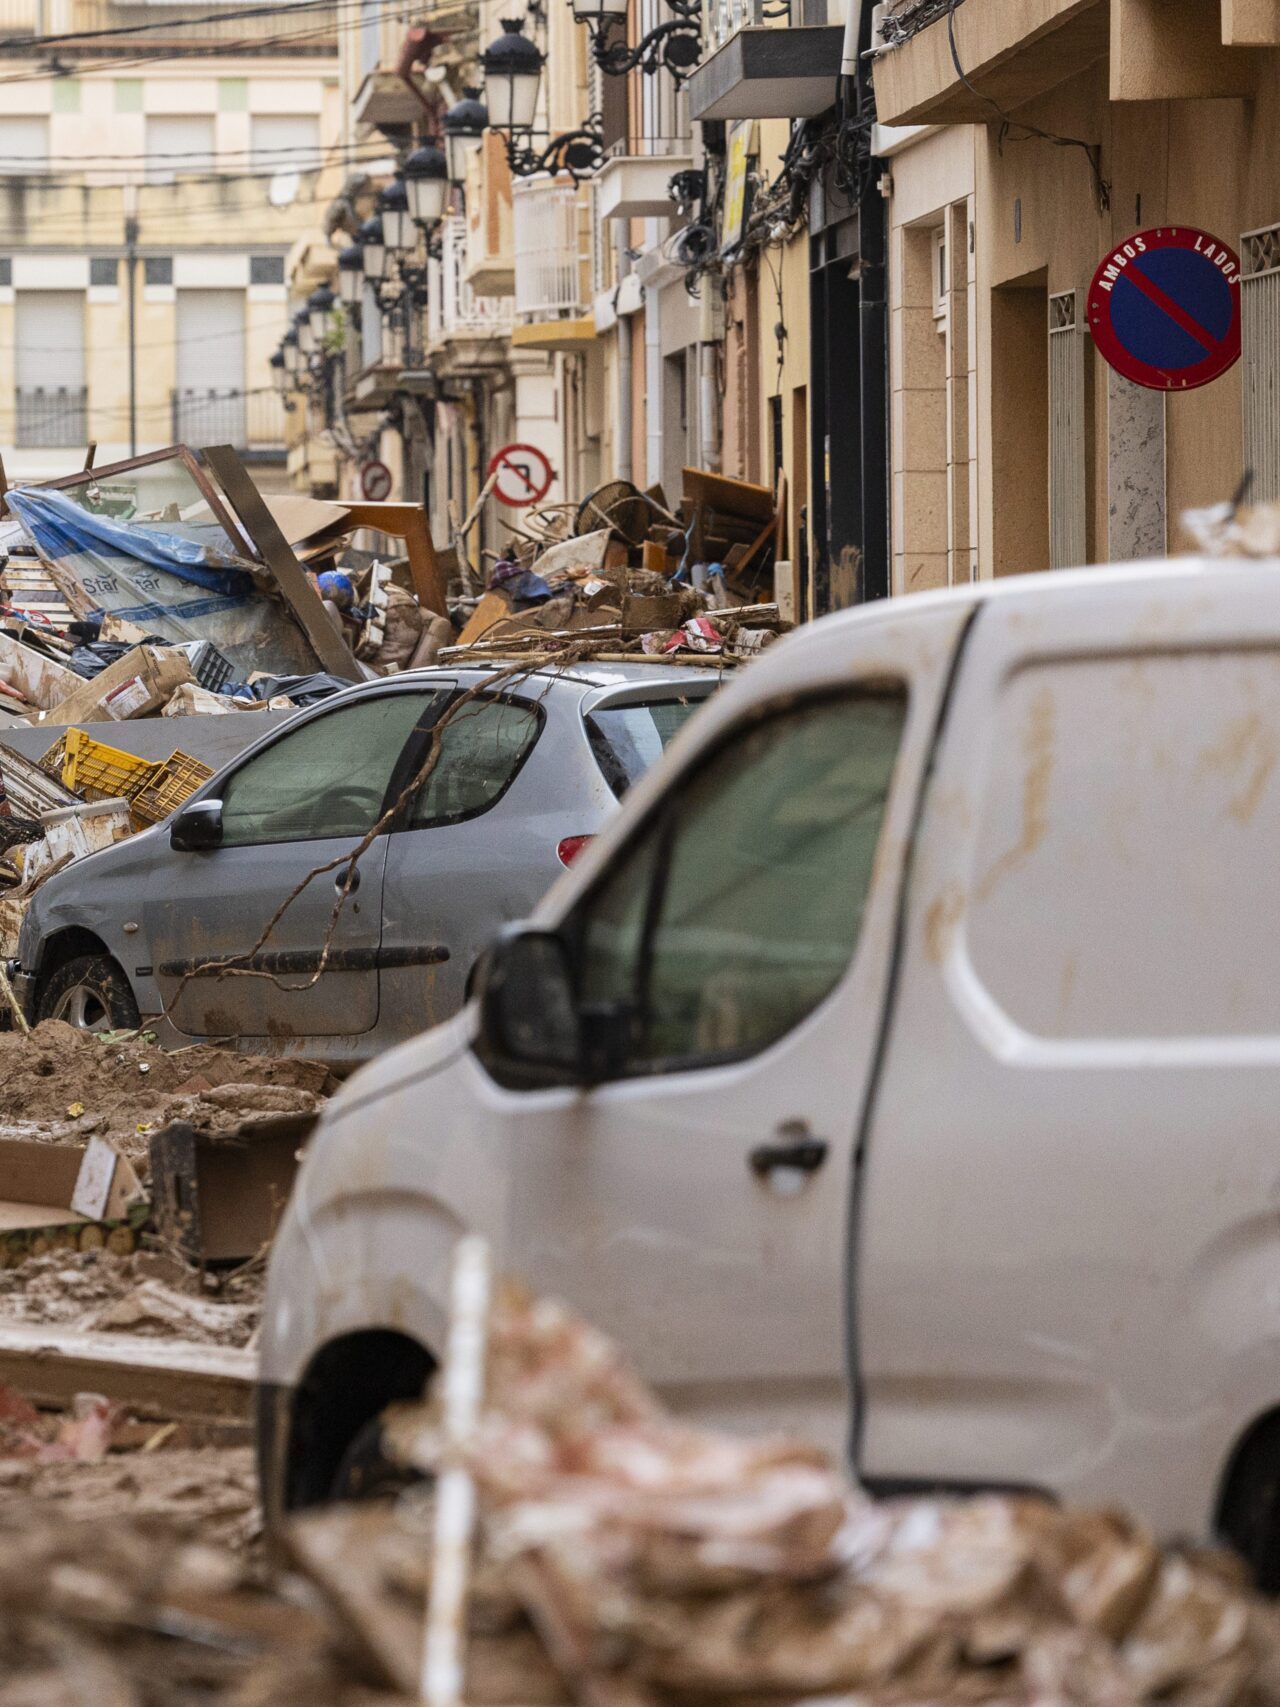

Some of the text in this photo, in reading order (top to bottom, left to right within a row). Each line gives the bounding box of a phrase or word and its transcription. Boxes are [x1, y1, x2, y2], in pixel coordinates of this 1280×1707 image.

[1098, 236, 1242, 291] AMBOS LADOS
[82, 577, 118, 594] Star
[135, 577, 160, 592] tar
